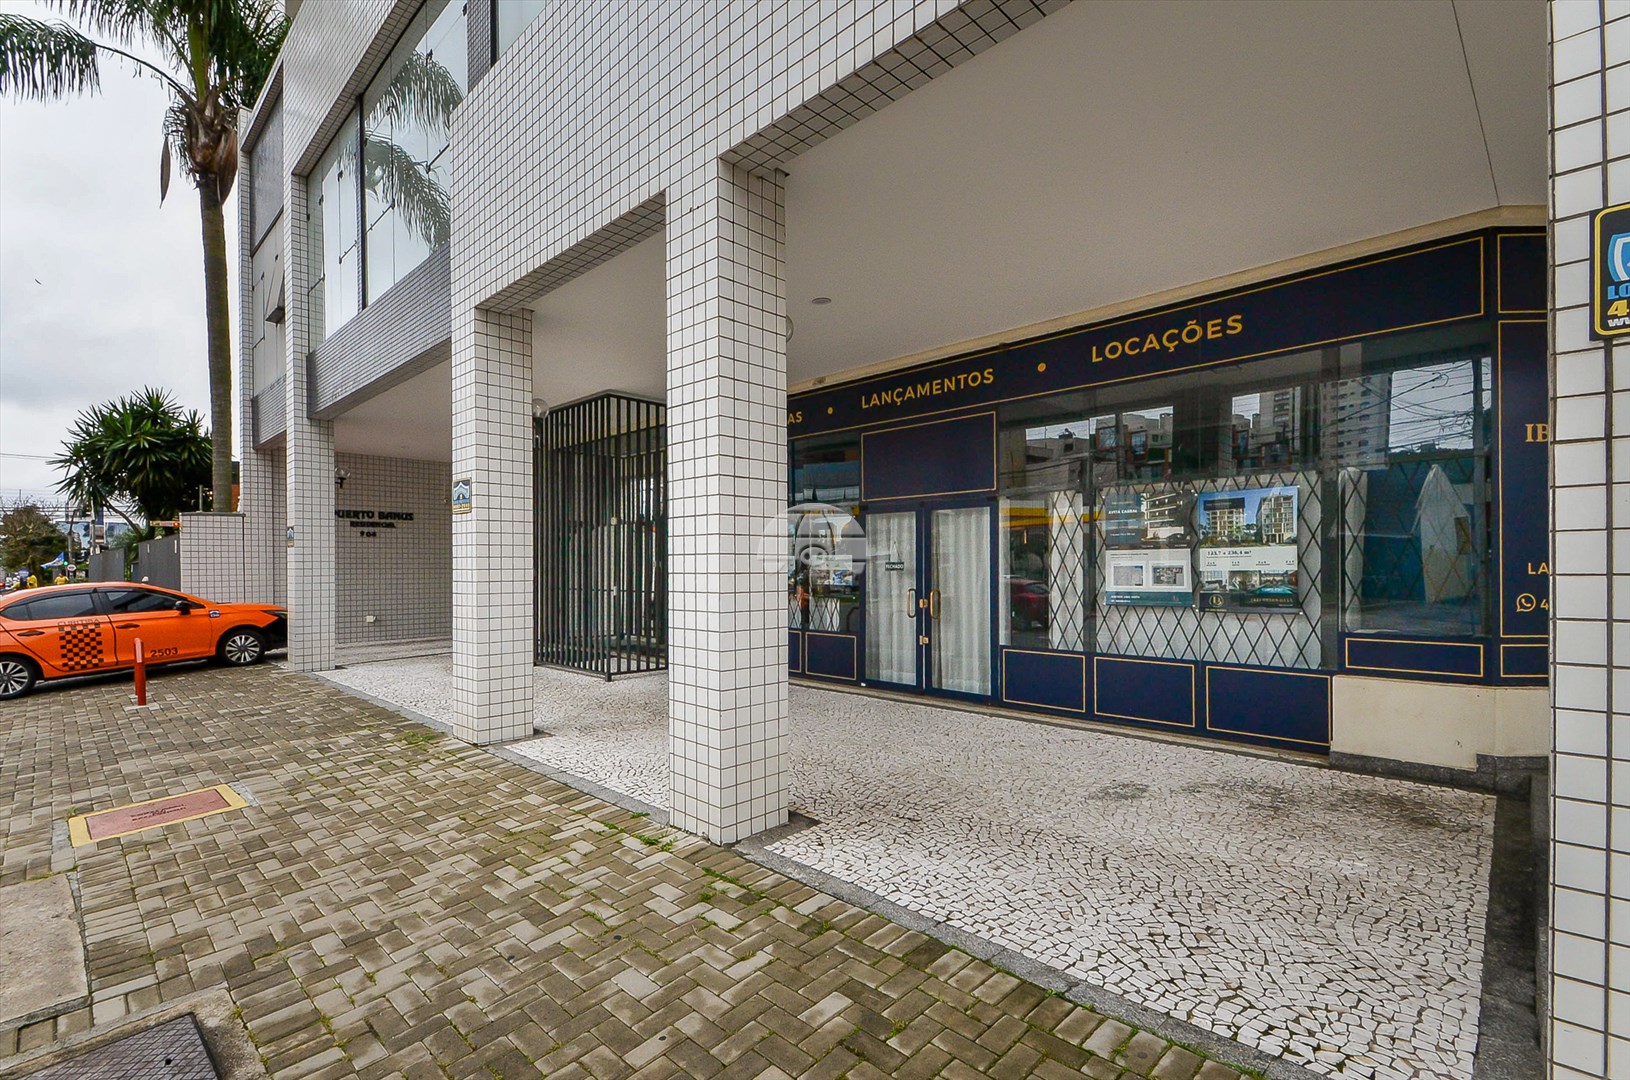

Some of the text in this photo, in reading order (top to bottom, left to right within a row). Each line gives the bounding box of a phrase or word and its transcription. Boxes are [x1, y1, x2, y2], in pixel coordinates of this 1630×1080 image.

[861, 368, 994, 409] LANÇAMENTOS
[1091, 314, 1244, 363] LOCAÇÕES
[150, 647, 179, 658] 2503
